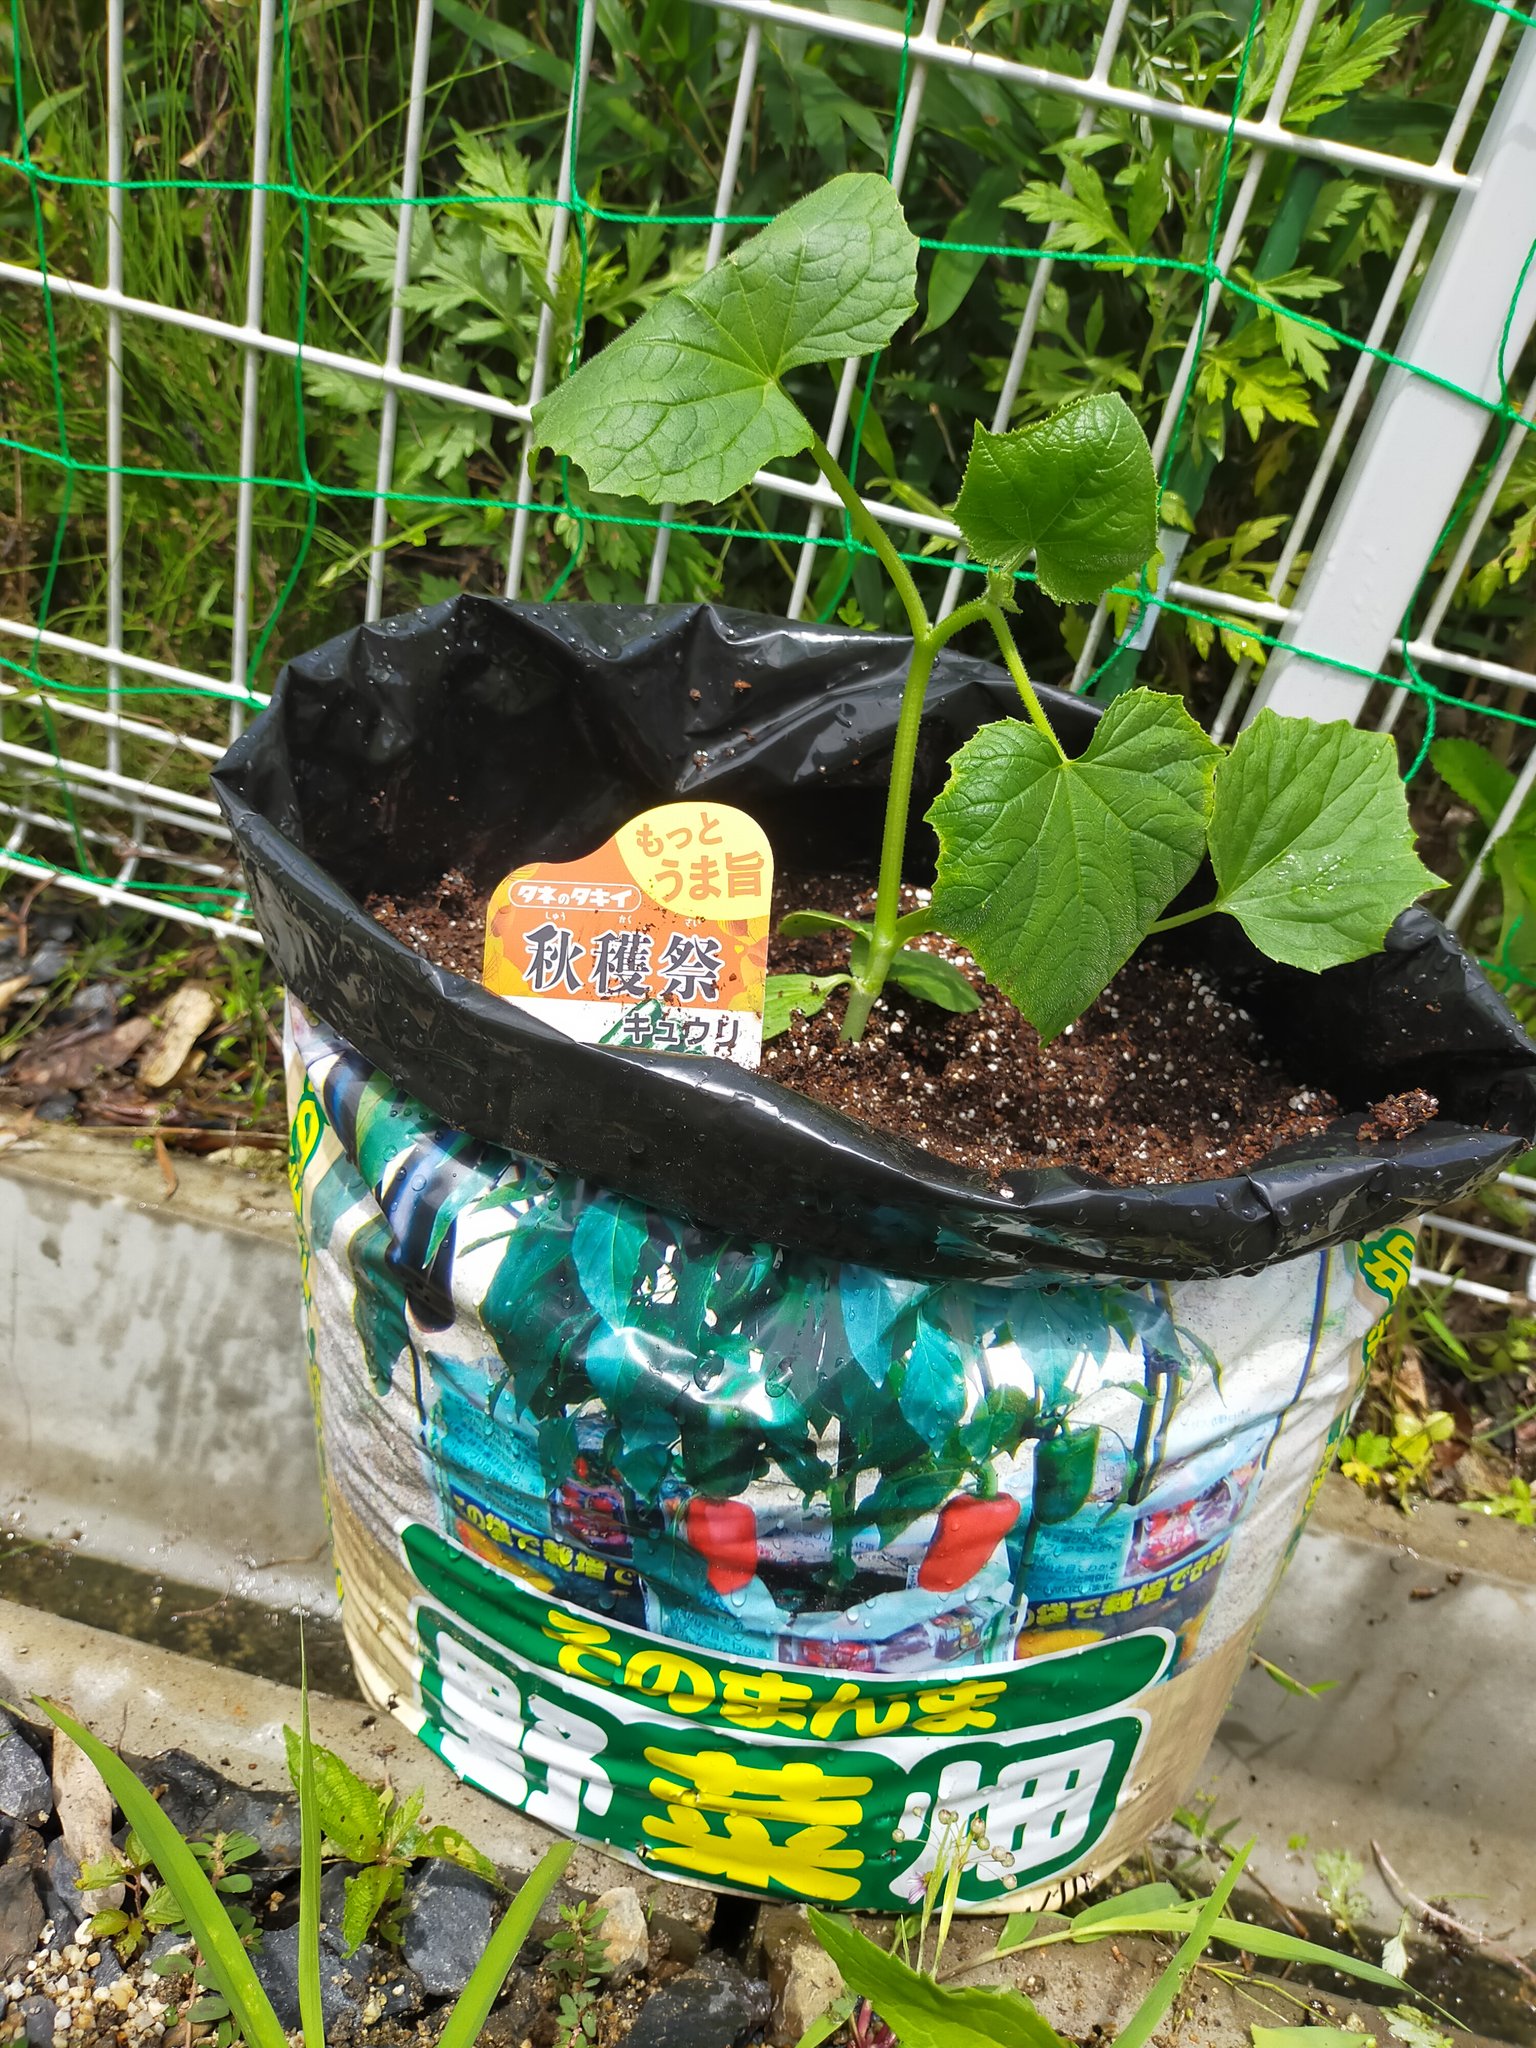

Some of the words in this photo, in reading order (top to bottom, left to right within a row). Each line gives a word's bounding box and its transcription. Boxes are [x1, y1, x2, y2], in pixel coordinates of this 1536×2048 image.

[636, 811, 723, 858] もっと
[516, 884, 633, 909] タネのタキイ
[654, 850, 765, 904] うま旨
[524, 923, 722, 1001] 秋穫祭
[623, 1012, 739, 1047] キュウリ
[541, 1609, 1008, 1742] そのまんま
[435, 1630, 1116, 1903] 野菜畑
